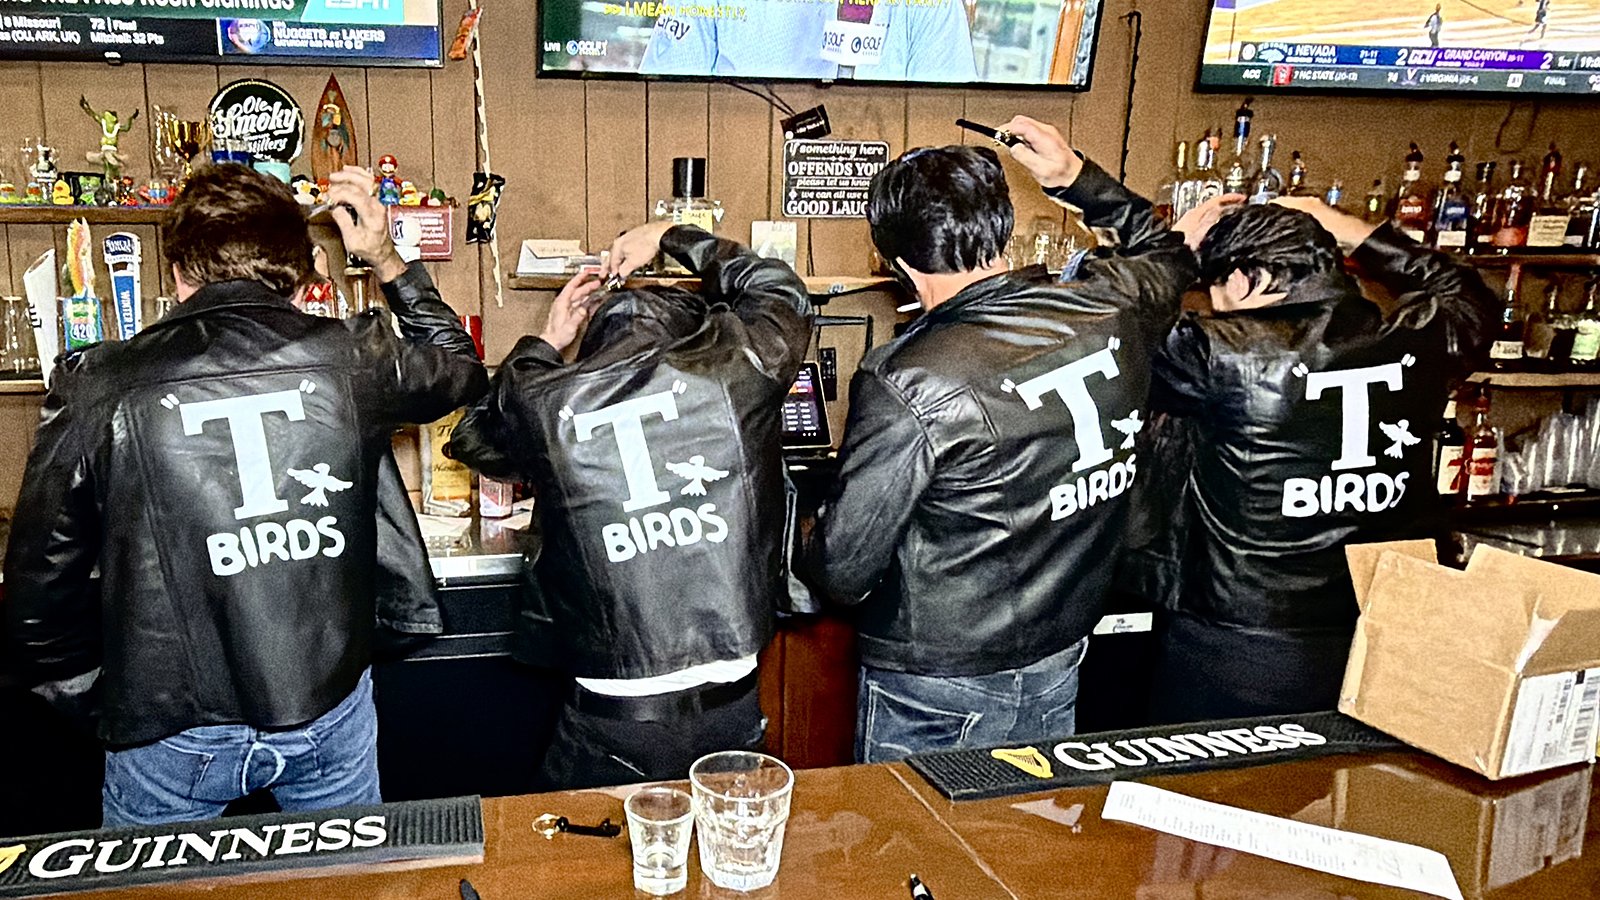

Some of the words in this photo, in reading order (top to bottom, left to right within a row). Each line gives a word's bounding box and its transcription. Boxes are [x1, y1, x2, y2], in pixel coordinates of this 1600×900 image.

[633, 2, 676, 17] MEAN
[12, 16, 61, 29] Missouri
[90, 18, 105, 30] 72
[133, 33, 147, 44] 32
[148, 33, 164, 44] Pts
[273, 27, 327, 40] NUGGETS
[342, 29, 385, 42] LAKERS
[1295, 45, 1336, 57] NEVADA
[1395, 48, 1408, 66] 2
[1443, 50, 1471, 61] GRAND
[1472, 51, 1509, 63] CANYON
[1540, 53, 1553, 70] 2
[243, 96, 273, 114] Ole
[212, 101, 298, 138] Smoky
[800, 143, 857, 158] something
[859, 142, 885, 155] here
[788, 161, 853, 176] OFFENDS
[797, 176, 825, 188] please
[826, 177, 838, 187] let
[839, 178, 850, 187] us
[851, 177, 870, 187] kno
[801, 191, 815, 199] we
[833, 190, 846, 199] all
[786, 200, 830, 216] GOOD
[1049, 453, 1137, 521] BIRDS
[1281, 471, 1410, 518] BIRDS
[601, 502, 729, 563] BIRDS
[206, 515, 346, 576] BIRDS
[1053, 723, 1327, 771] GUINNESS
[28, 815, 388, 879] GUINNESS
